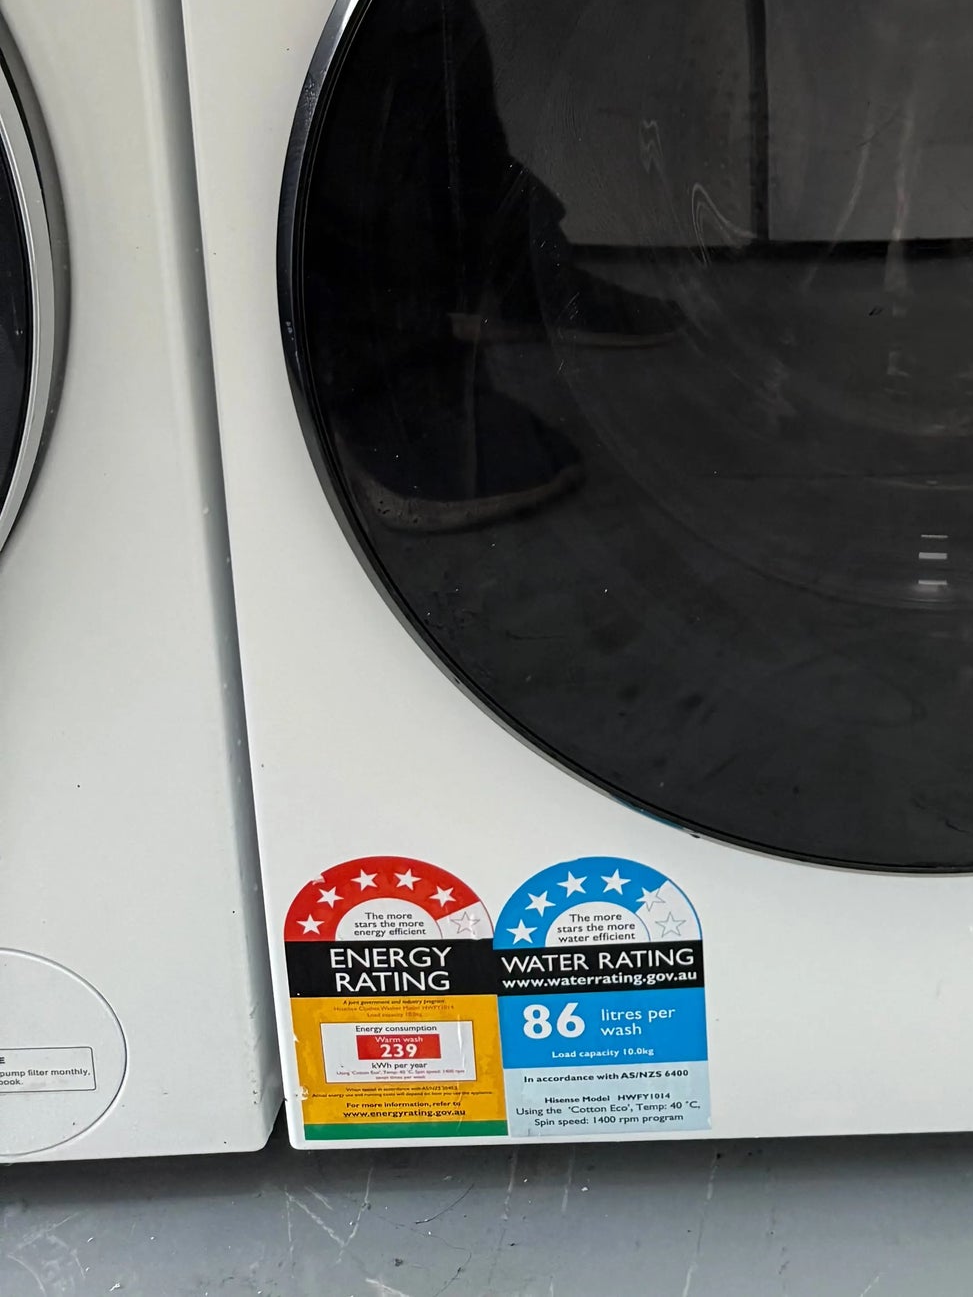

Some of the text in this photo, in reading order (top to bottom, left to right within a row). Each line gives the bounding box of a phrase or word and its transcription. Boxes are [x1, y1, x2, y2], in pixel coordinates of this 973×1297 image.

[364, 912, 413, 920] The more
[569, 913, 622, 923] The more
[380, 920, 396, 928] the
[398, 920, 425, 928] more
[556, 923, 636, 933] stars the more
[354, 928, 427, 938] energy efficient
[558, 932, 636, 943] water efficient
[329, 946, 452, 969] ENERGY
[501, 948, 695, 974] WATER RATING
[335, 970, 451, 993] RATING
[502, 971, 698, 988] www.waterrating.gov.au
[522, 1002, 586, 1040] 86
[601, 1008, 676, 1023] litres per
[355, 1025, 437, 1033] Energy consumption
[600, 1023, 642, 1036] wash
[380, 1044, 418, 1058] 239
[552, 1048, 654, 1059] Load capacity 10.0kg
[0, 1068, 91, 1078] pump filter monthly,
[524, 1069, 689, 1083] In accordance with AS/NZS 6400
[544, 1092, 671, 1104] Hisense Model HWFY1014
[343, 1110, 466, 1118] www.energyrating.gov.au
[516, 1107, 544, 1116] Using
[546, 1106, 562, 1115] the
[568, 1104, 607, 1114] 'Cotton
[610, 1103, 633, 1113] Eco',
[635, 1103, 668, 1112] Temp:
[670, 1101, 682, 1109] 40
[534, 1114, 684, 1127] Spin speed: 1400 rpm program
